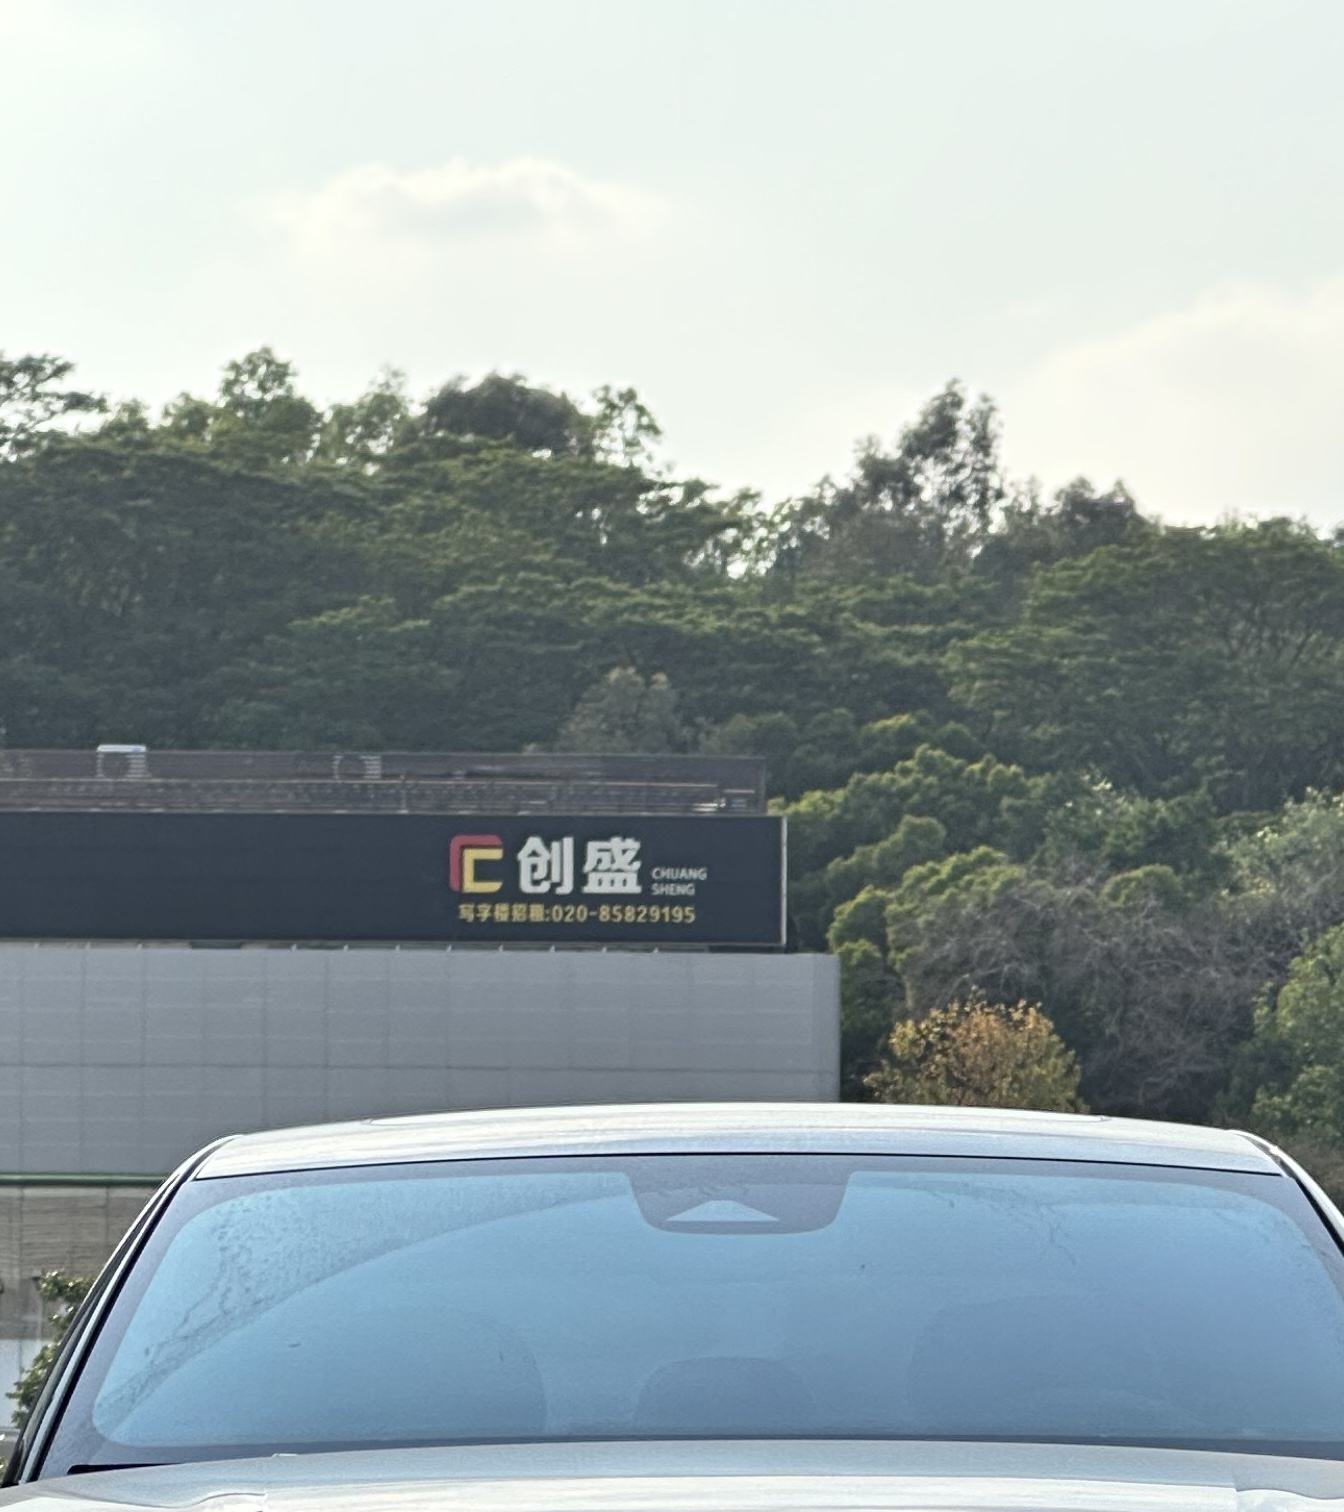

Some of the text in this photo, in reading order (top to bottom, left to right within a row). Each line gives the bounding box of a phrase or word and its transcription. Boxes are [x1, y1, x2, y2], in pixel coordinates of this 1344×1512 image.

[517, 836, 642, 895] 创盛
[651, 867, 707, 880] CHUANG
[651, 883, 695, 895] SHENG
